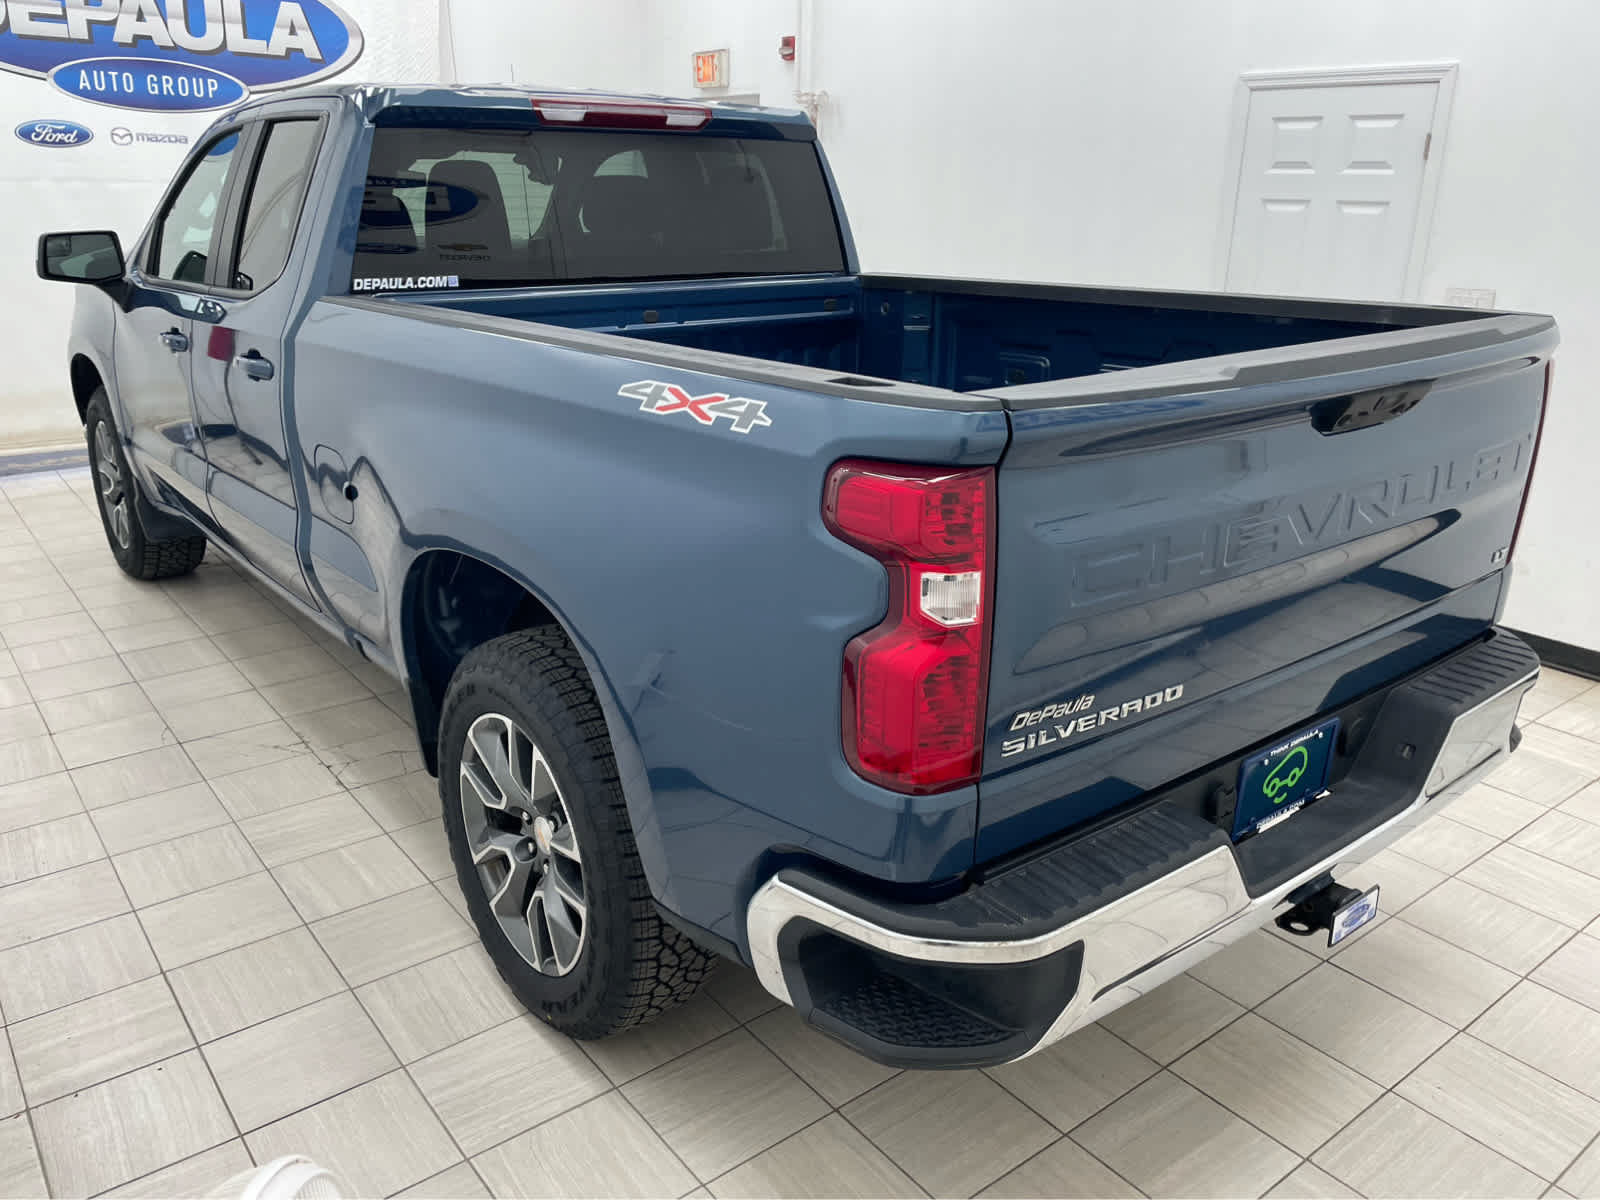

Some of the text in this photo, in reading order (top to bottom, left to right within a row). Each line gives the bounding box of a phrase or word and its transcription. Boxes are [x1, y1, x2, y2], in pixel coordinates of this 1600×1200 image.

[0, 0, 323, 59] EPAULA
[79, 69, 219, 99] AUTO GROUP
[31, 123, 78, 143] Ford
[353, 276, 448, 291] DEPAULA.COM
[1070, 434, 1532, 608] CHEVROLET
[1001, 684, 1184, 757] SILVERADO
[1010, 694, 1095, 732] DePaula
